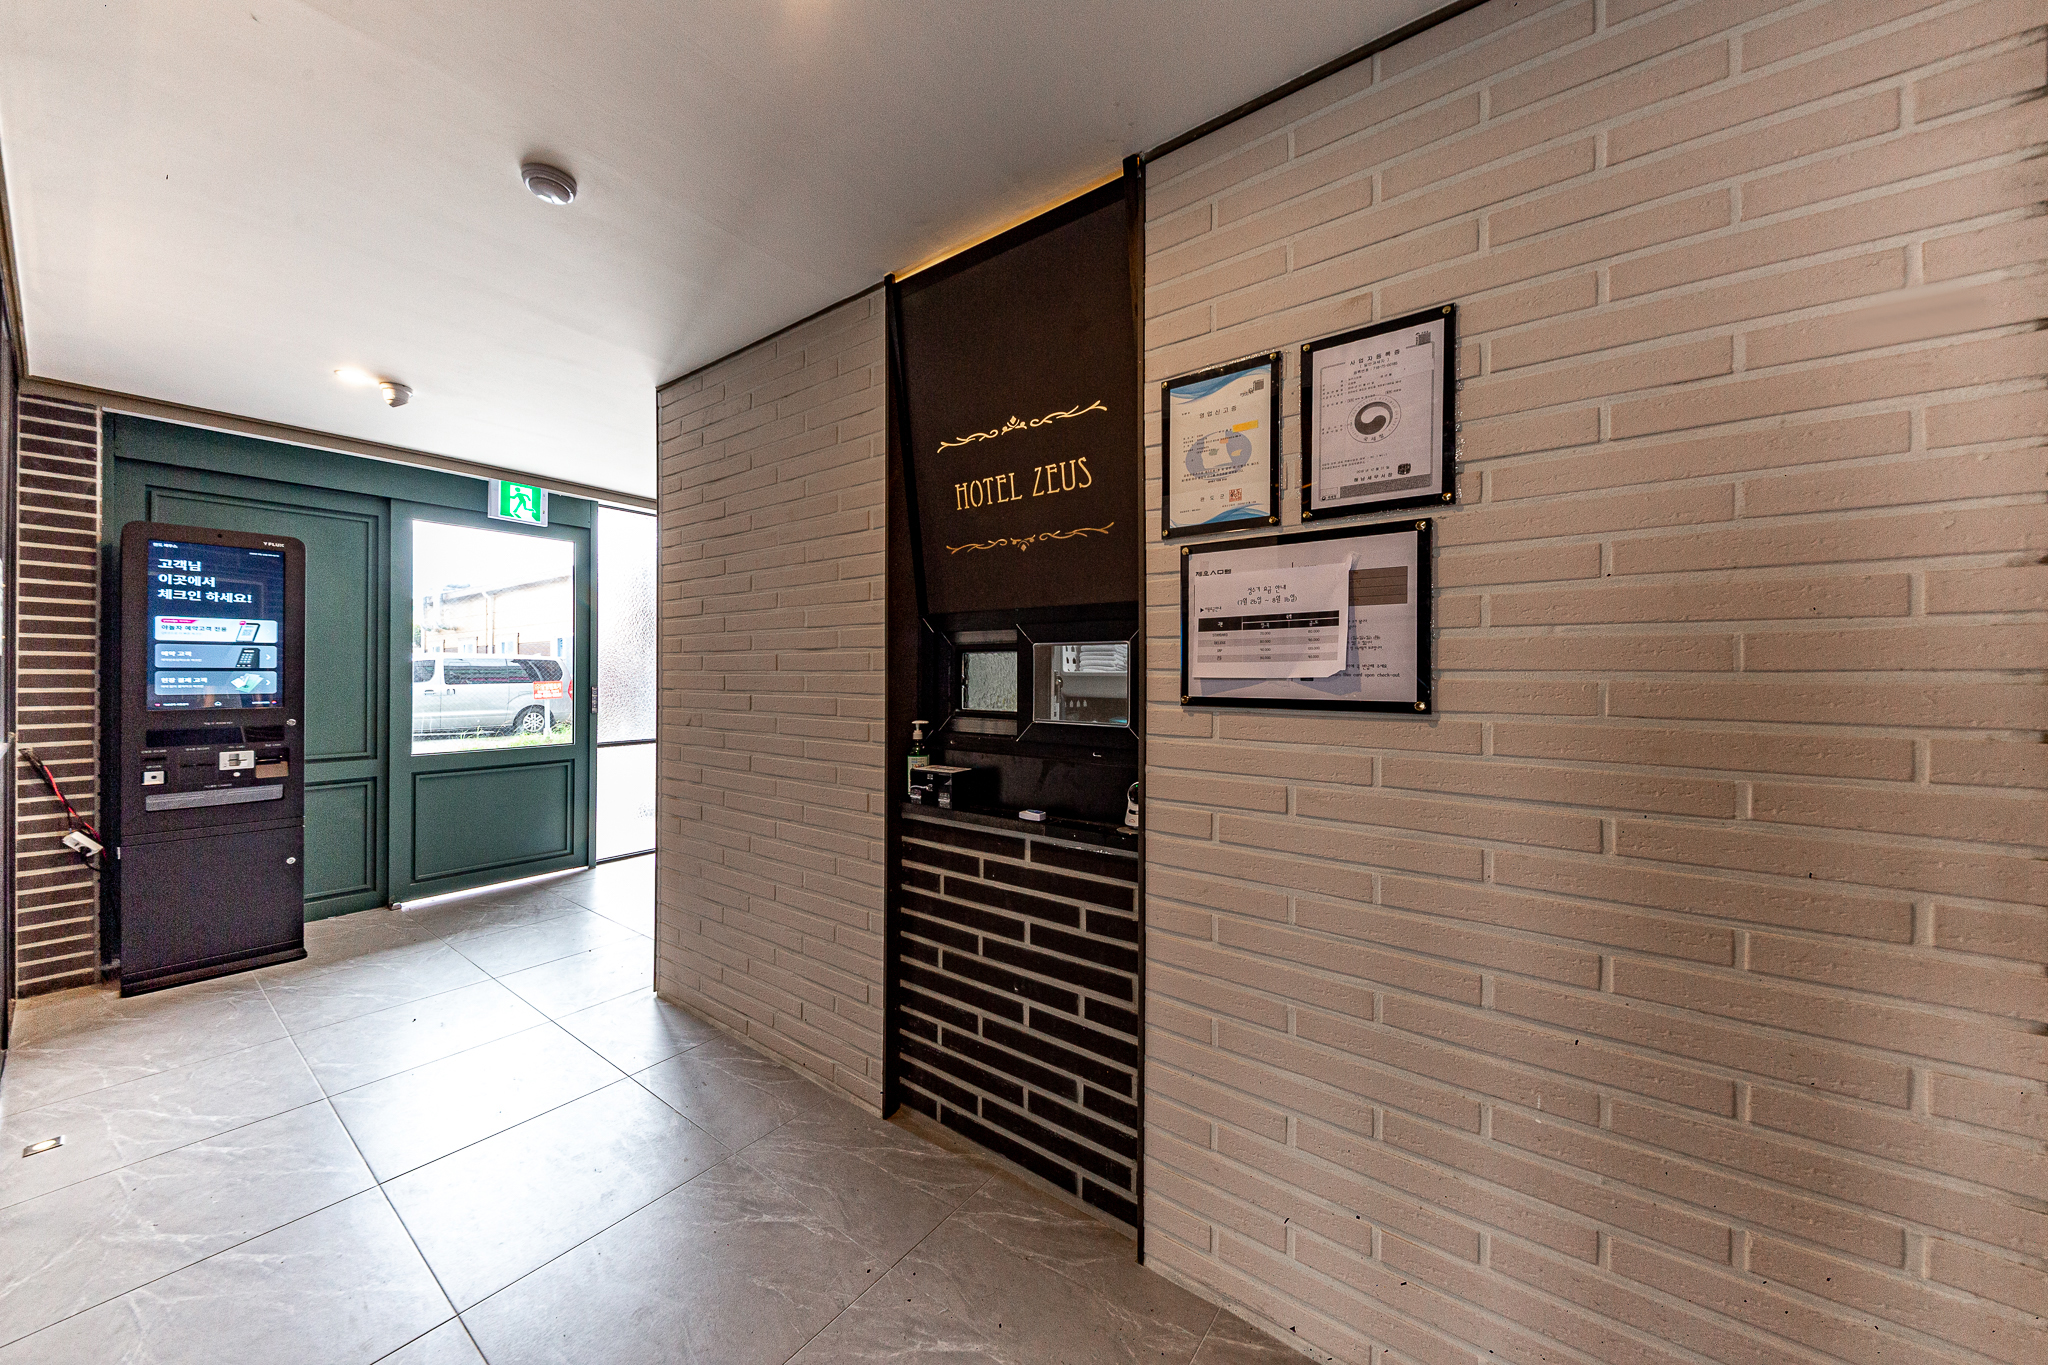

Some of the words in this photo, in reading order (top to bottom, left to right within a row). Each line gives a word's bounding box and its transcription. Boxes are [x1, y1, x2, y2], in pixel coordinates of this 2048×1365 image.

[954, 472, 1023, 511] HOTEL
[1032, 456, 1093, 497] ZEUS
[157, 558, 202, 572] 고객님
[157, 573, 216, 588] 이곳에서
[157, 588, 202, 602] 체크인
[205, 591, 253, 604] 하세요!
